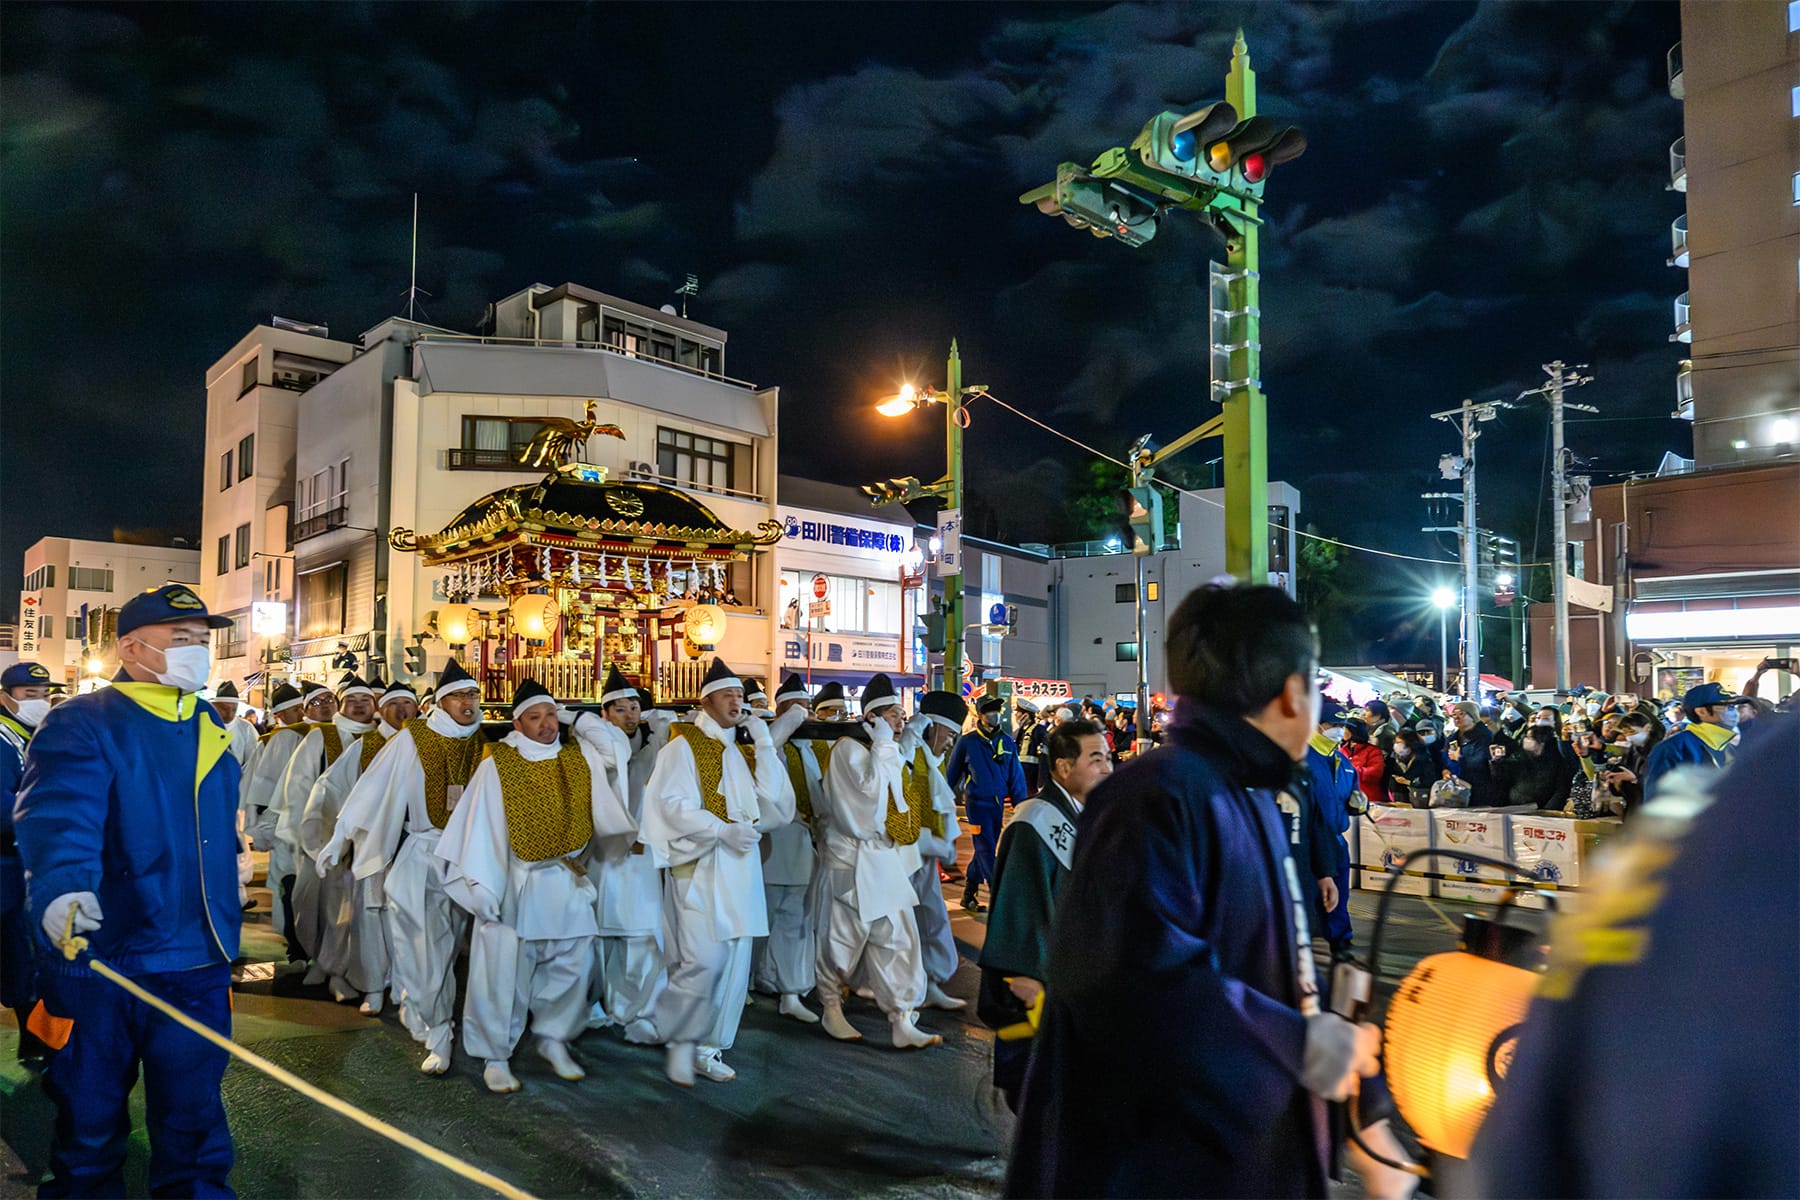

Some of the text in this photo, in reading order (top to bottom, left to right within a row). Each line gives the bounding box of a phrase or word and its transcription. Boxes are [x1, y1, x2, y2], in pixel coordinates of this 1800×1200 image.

[802, 521, 905, 553] 田川警備保障(株)
[23, 608, 35, 652] 住友生命
[1523, 827, 1567, 841] 可燃ごみ
